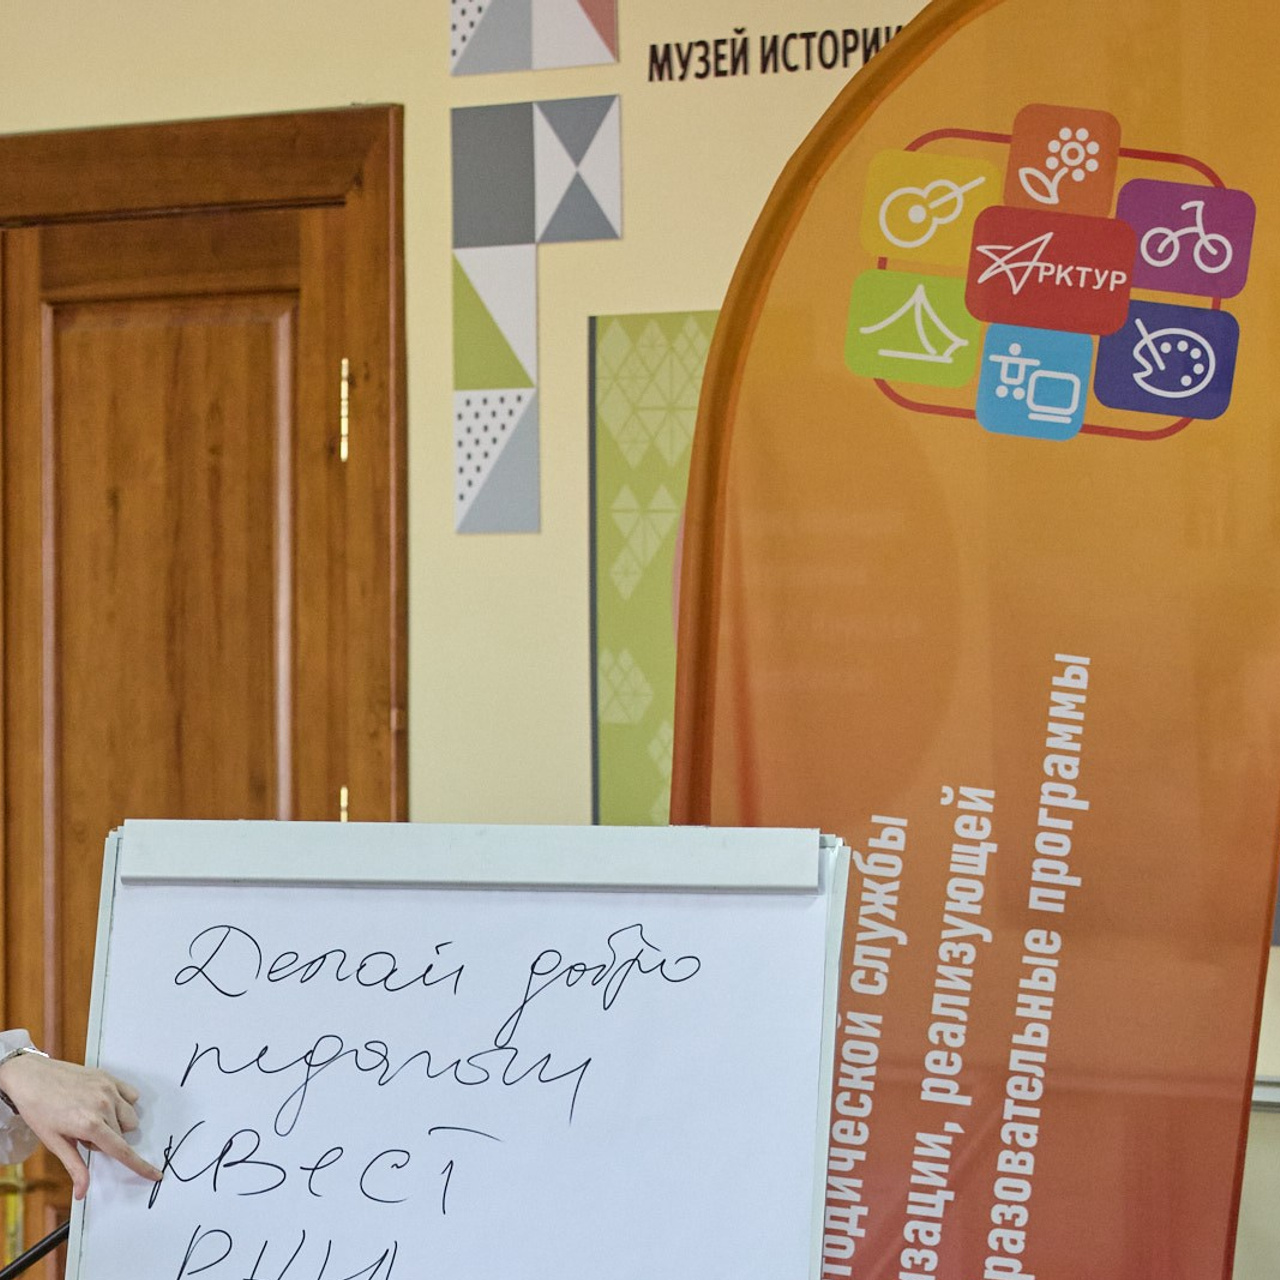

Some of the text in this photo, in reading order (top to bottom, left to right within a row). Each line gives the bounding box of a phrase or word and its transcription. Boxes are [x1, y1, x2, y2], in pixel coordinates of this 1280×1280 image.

[647, 27, 750, 82] МУЗЕЙ
[1028, 652, 1092, 915] программы
[850, 814, 909, 996] службы
[920, 785, 998, 1107] реализующей
